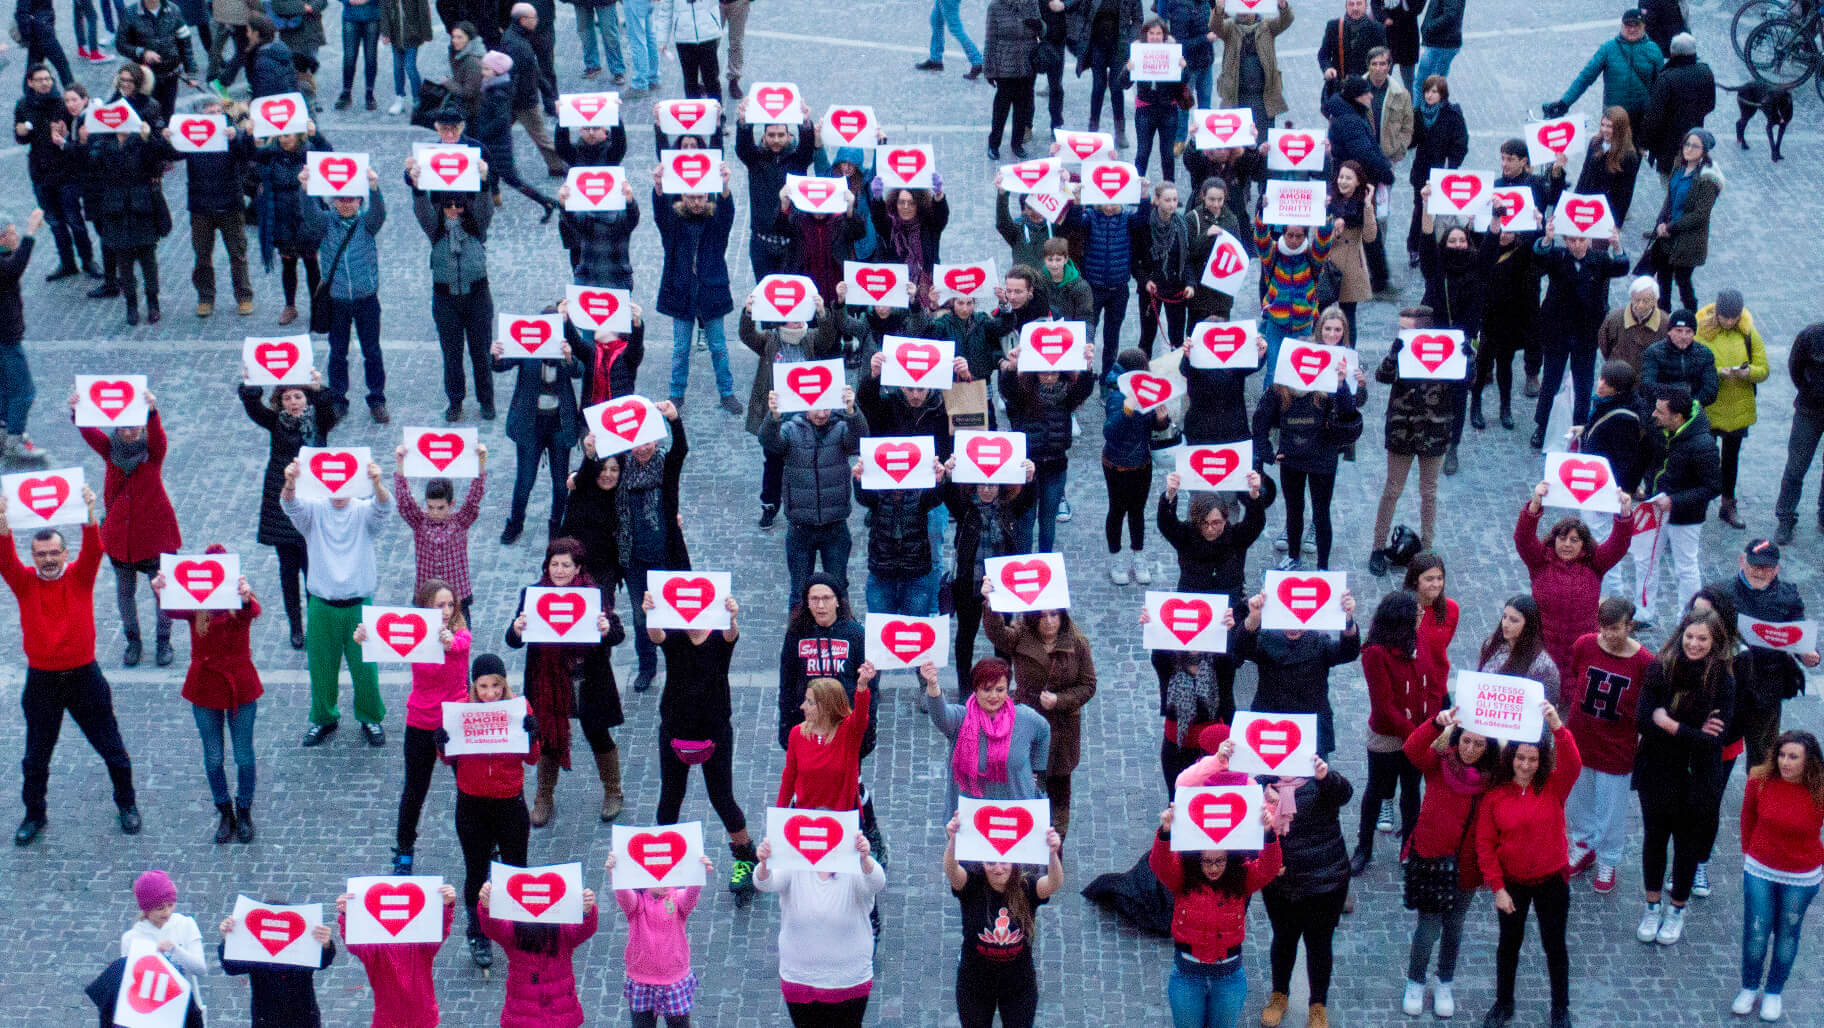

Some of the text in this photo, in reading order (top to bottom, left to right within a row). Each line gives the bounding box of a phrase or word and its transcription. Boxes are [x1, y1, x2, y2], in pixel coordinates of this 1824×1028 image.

[1477, 683, 1525, 696] LO STESSO
[1580, 665, 1632, 721] H
[1476, 691, 1525, 705] AMORE
[1476, 700, 1524, 713] GLI STESSI
[463, 716, 508, 725] AMORE
[1475, 707, 1522, 722] DIRITTI
[464, 727, 509, 737] DIRITTI
